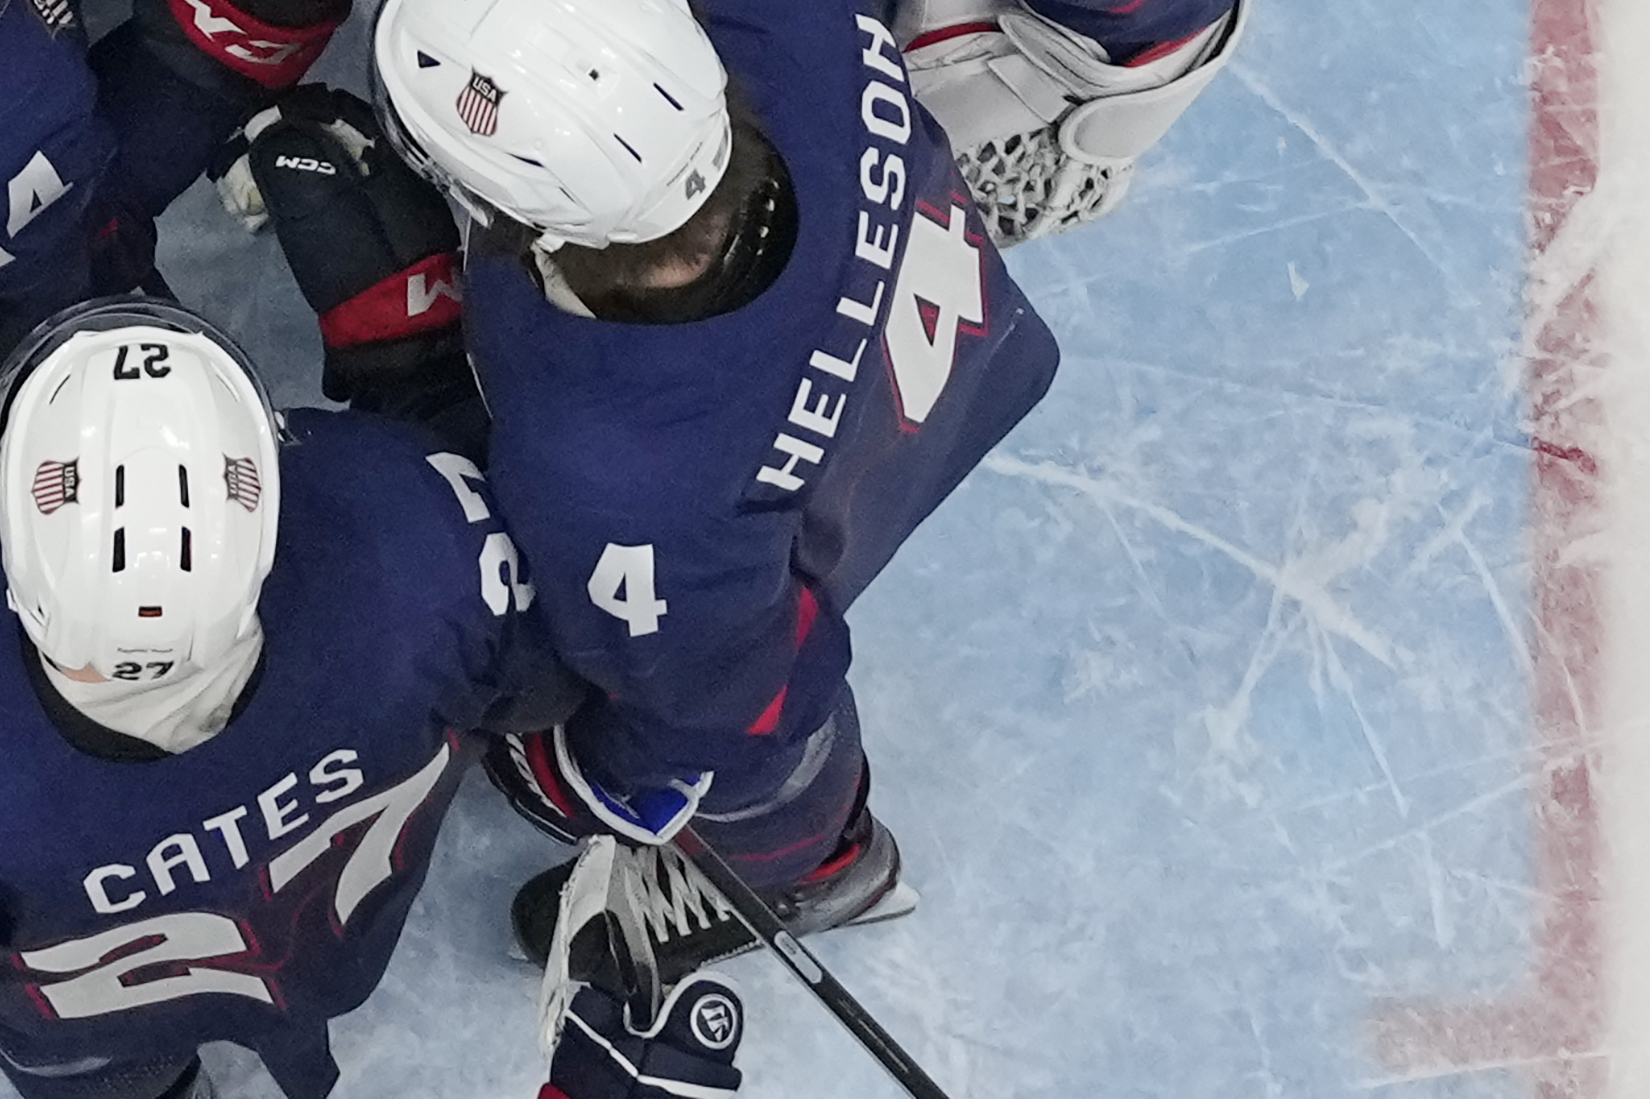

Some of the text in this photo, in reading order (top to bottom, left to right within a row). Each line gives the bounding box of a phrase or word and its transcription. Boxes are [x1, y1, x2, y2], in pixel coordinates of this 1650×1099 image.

[472, 76, 498, 102] USA
[276, 156, 336, 175] CCM
[685, 169, 706, 201] 4
[886, 203, 984, 423] 4
[113, 344, 172, 380] 27
[65, 465, 76, 498] USA
[588, 542, 668, 637] 4
[112, 661, 174, 682] 27
[83, 748, 364, 914] CATES
[20, 742, 449, 1019] 27
